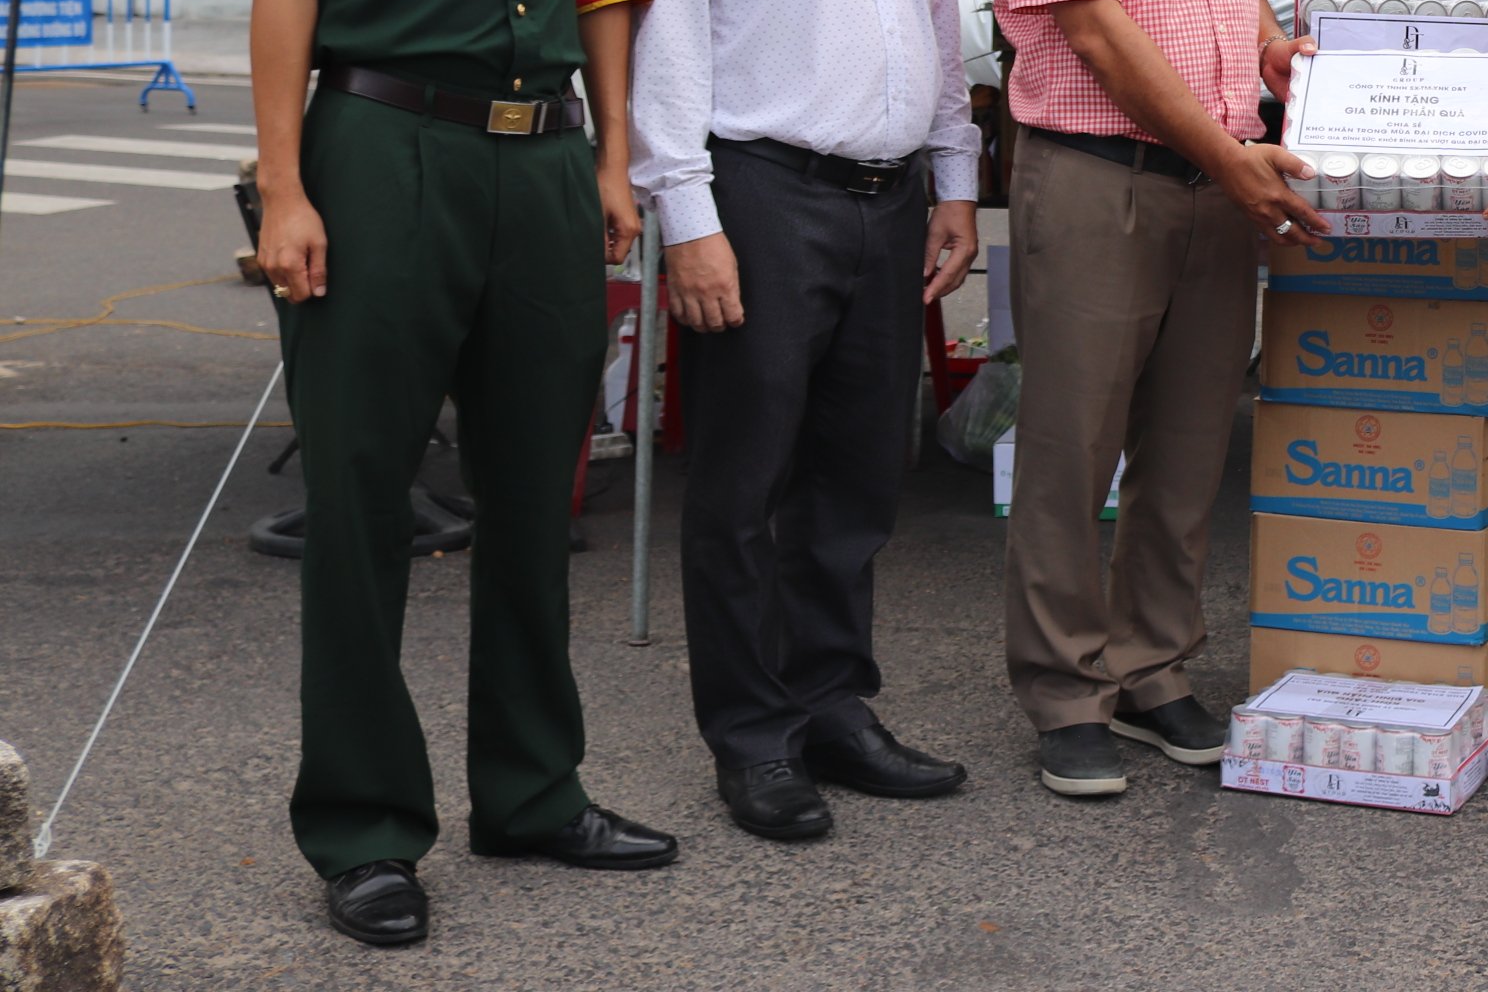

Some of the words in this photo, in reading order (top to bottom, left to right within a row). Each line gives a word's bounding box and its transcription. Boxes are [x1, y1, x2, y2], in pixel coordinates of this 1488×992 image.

[1344, 106, 1367, 115] GIA
[1370, 106, 1400, 116] ĐÌNH
[1369, 92, 1401, 104] KÍNH
[1404, 94, 1440, 106] TẶNG
[1357, 127, 1388, 135] TRONG
[1296, 329, 1428, 382] Sanna
[1285, 439, 1415, 494] Sanna
[1284, 555, 1416, 609] Sanna
